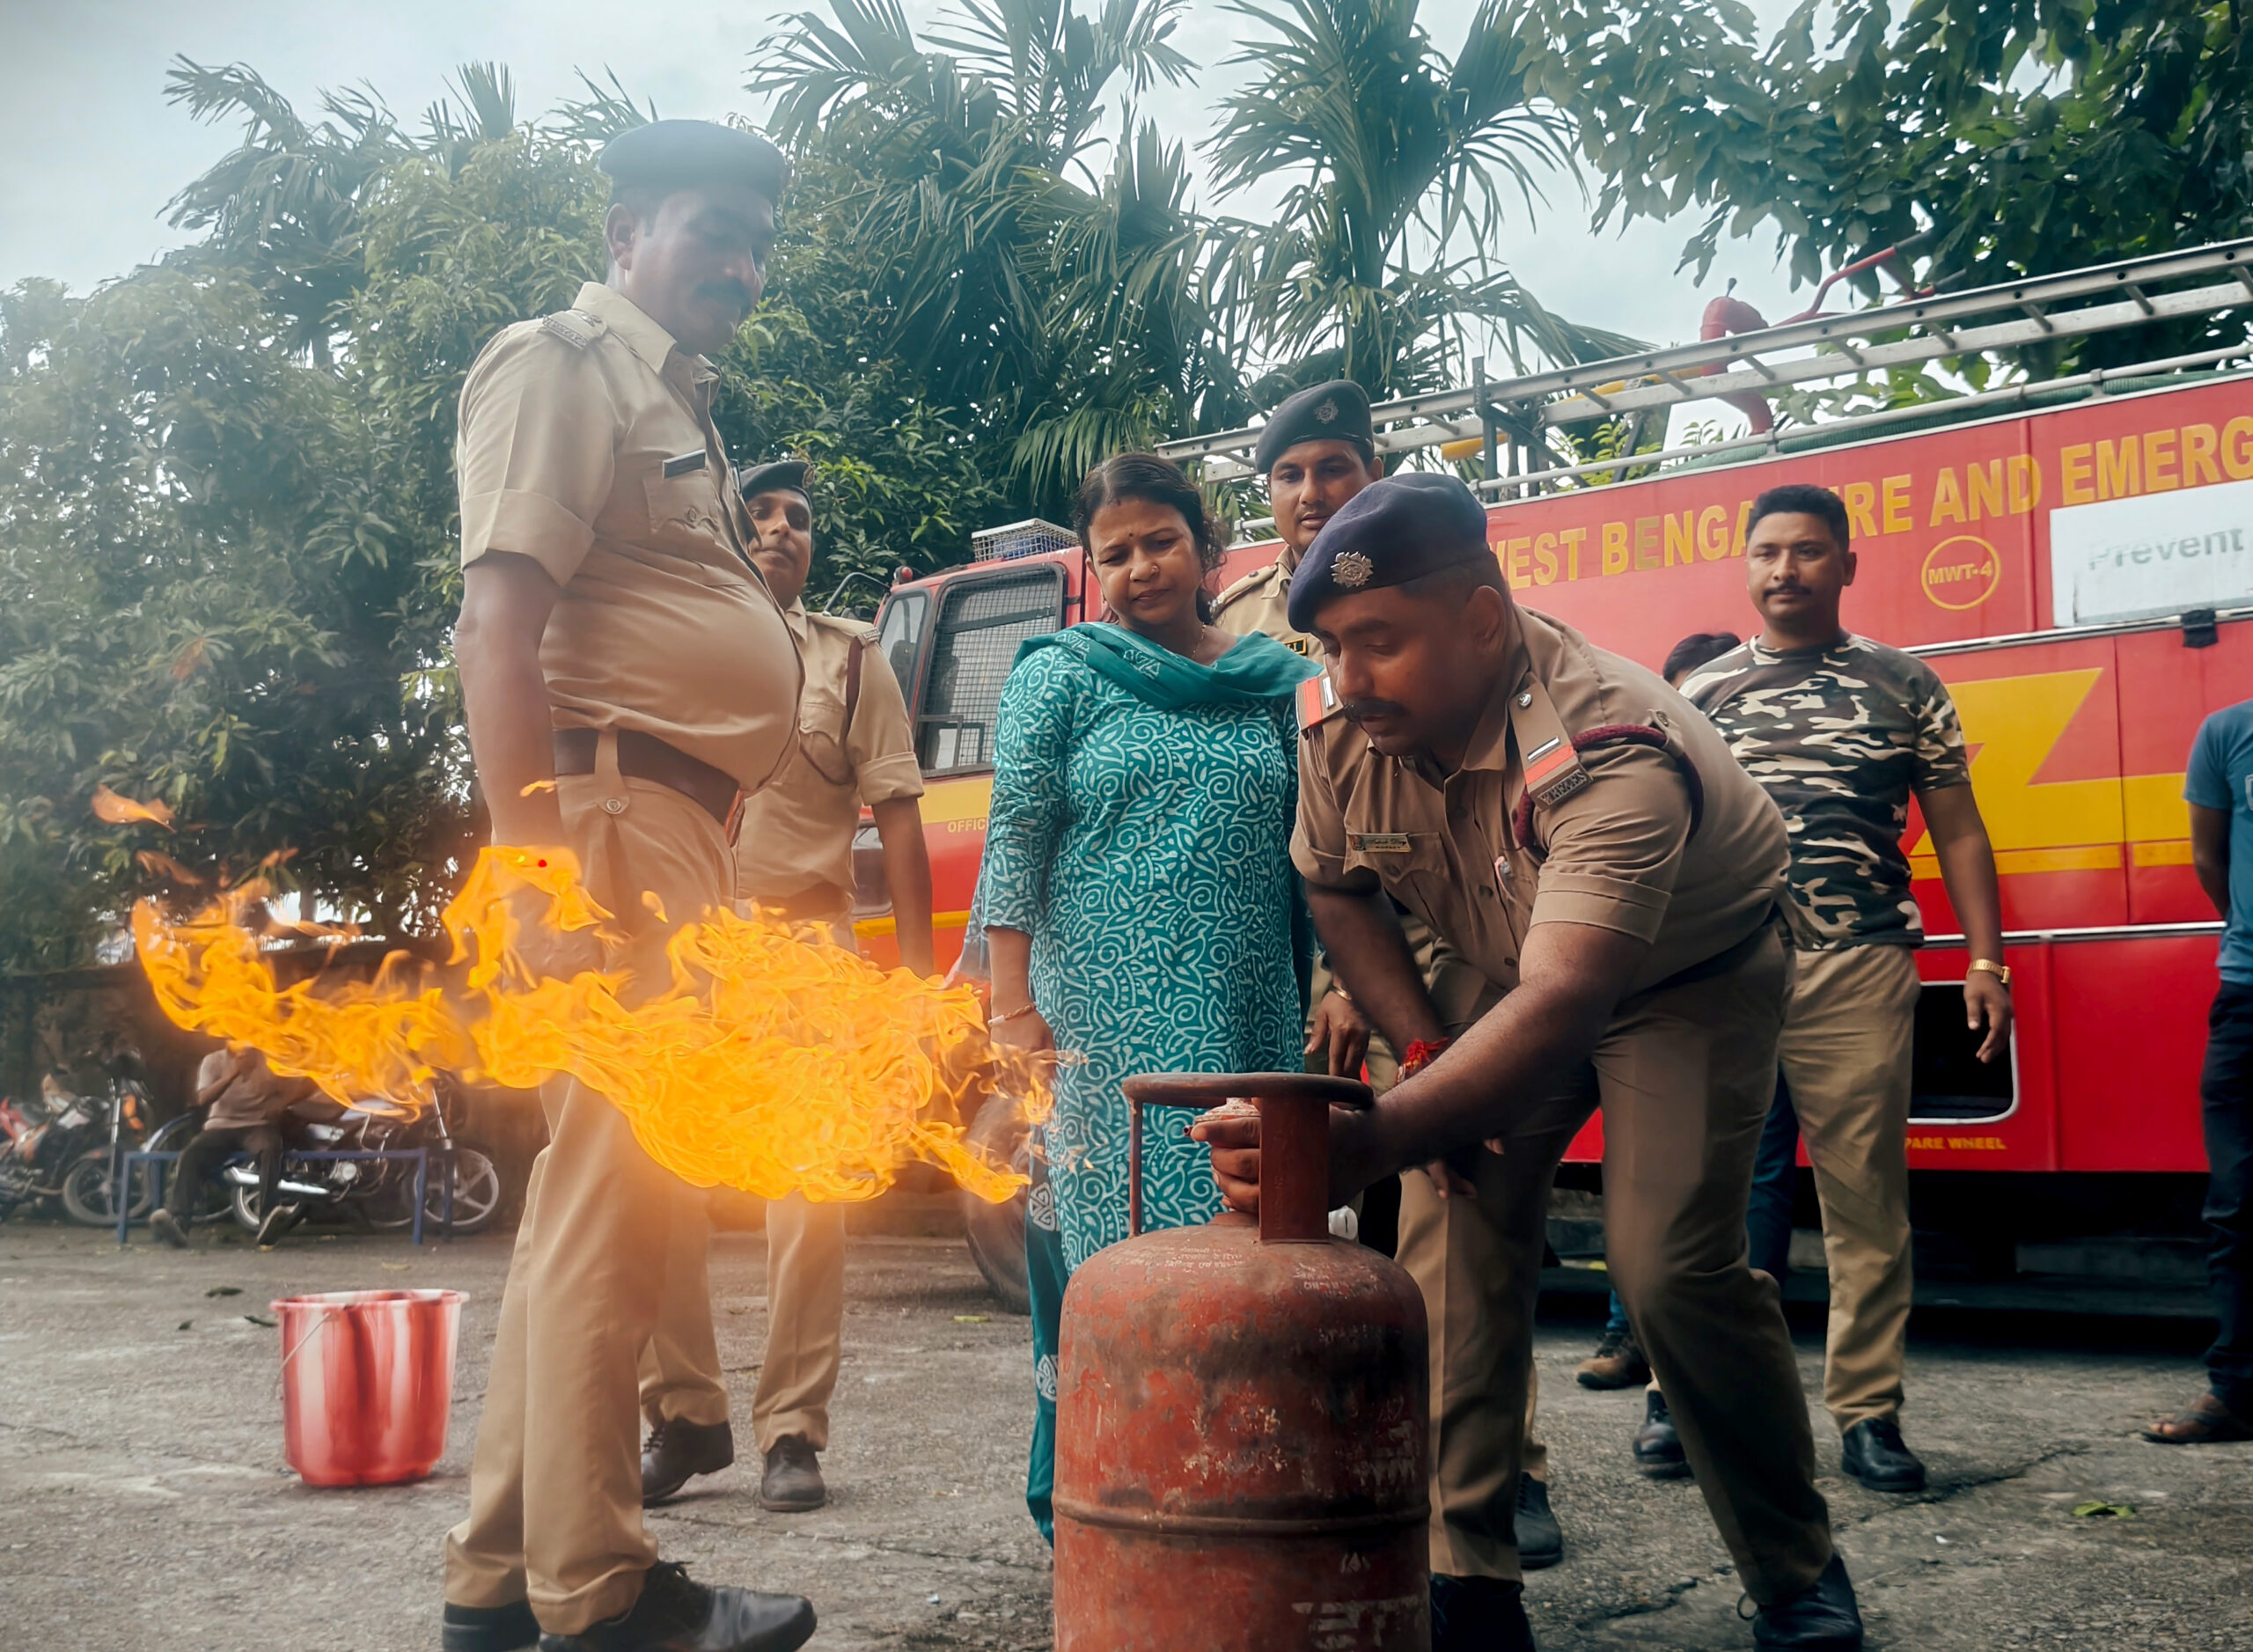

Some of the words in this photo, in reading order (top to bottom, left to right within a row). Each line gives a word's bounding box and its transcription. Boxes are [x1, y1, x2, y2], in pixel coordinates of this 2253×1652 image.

[1602, 499, 1754, 577] BENGA
[1929, 453, 2043, 528] AND
[2060, 415, 2253, 507] EMERG
[1927, 560, 1994, 585] MWT-4
[947, 818, 987, 833] OFFIC
[1904, 1136, 1946, 1150] PARE
[1947, 1136, 2007, 1150] WHEEL
